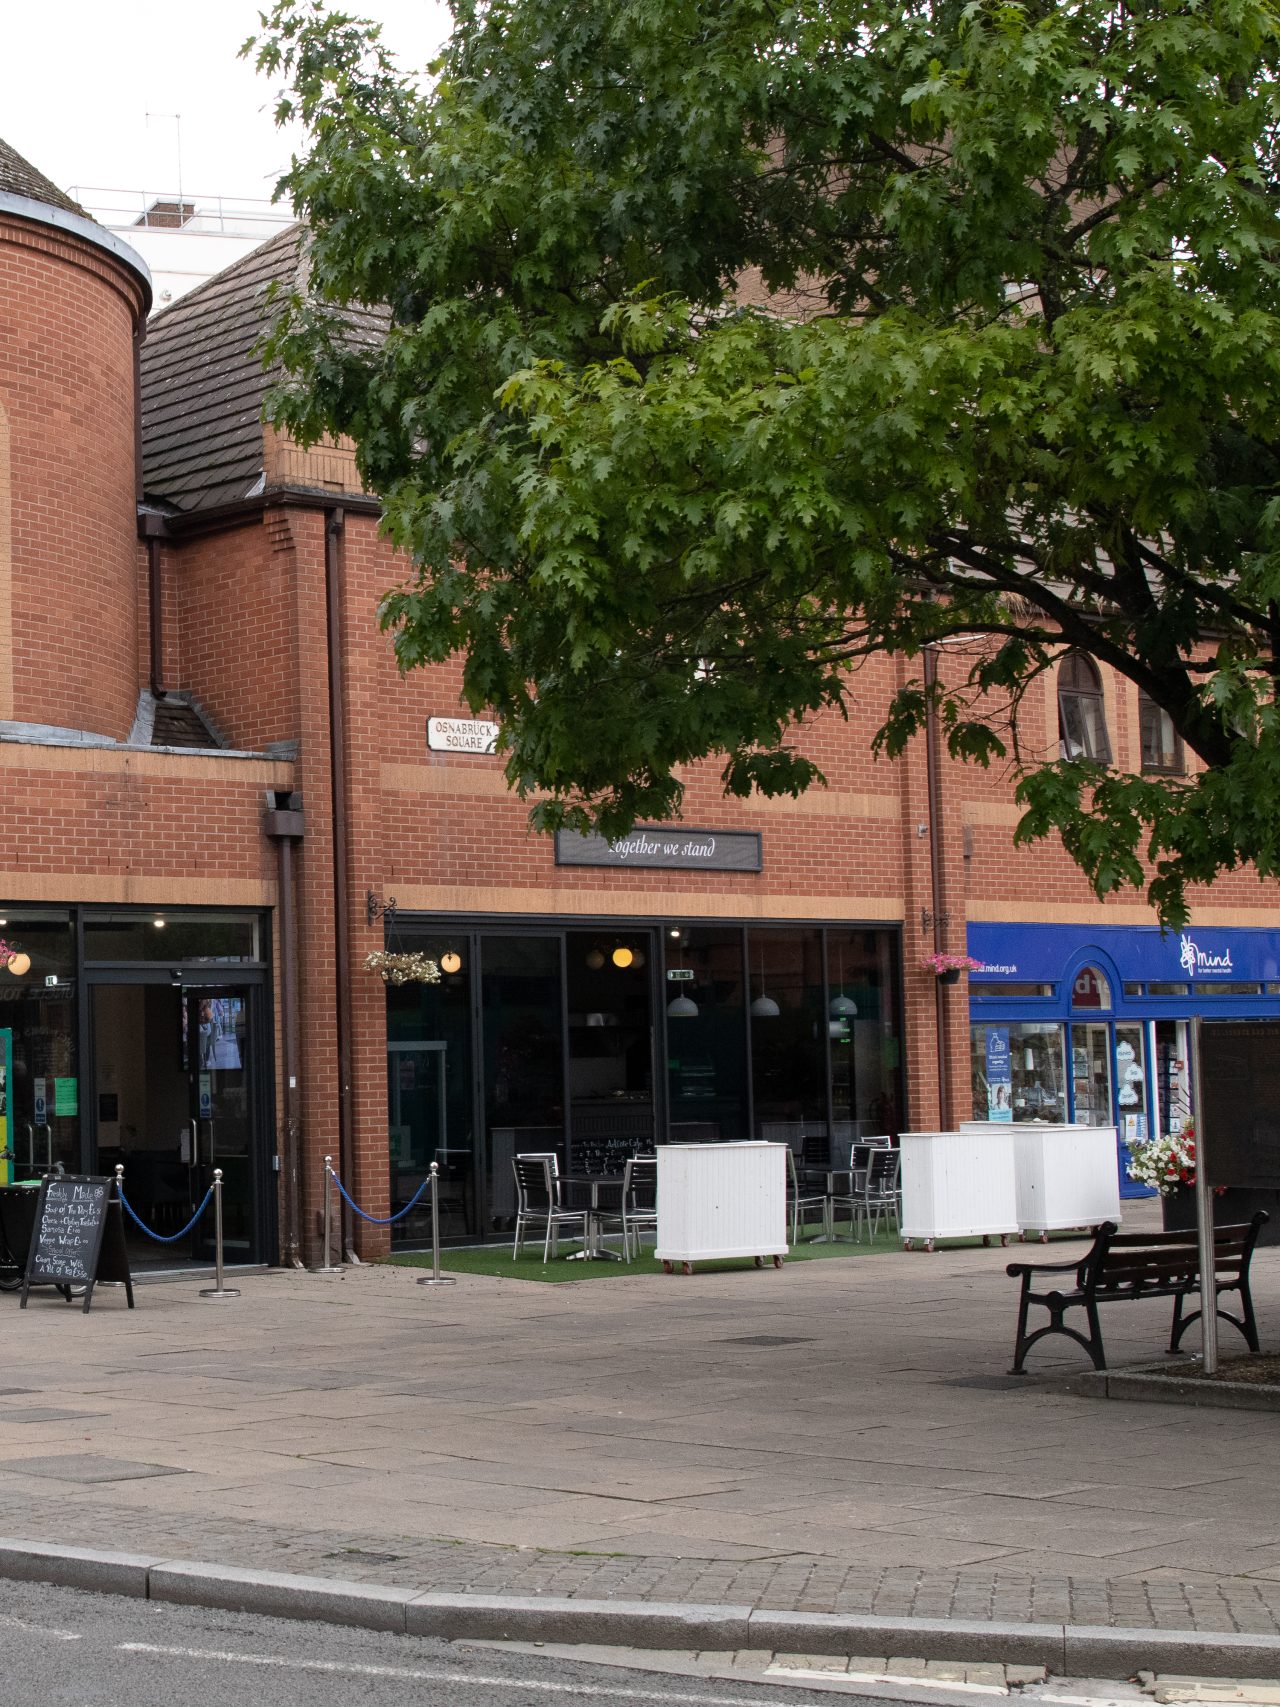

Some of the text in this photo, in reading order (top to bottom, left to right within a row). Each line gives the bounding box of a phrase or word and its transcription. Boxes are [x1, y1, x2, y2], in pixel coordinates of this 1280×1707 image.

[435, 721, 492, 737] OSNABRÜCK
[446, 735, 483, 749] SQUARE
[663, 842, 679, 855] we
[681, 837, 716, 857] stand
[73, 1185, 94, 1200] Made
